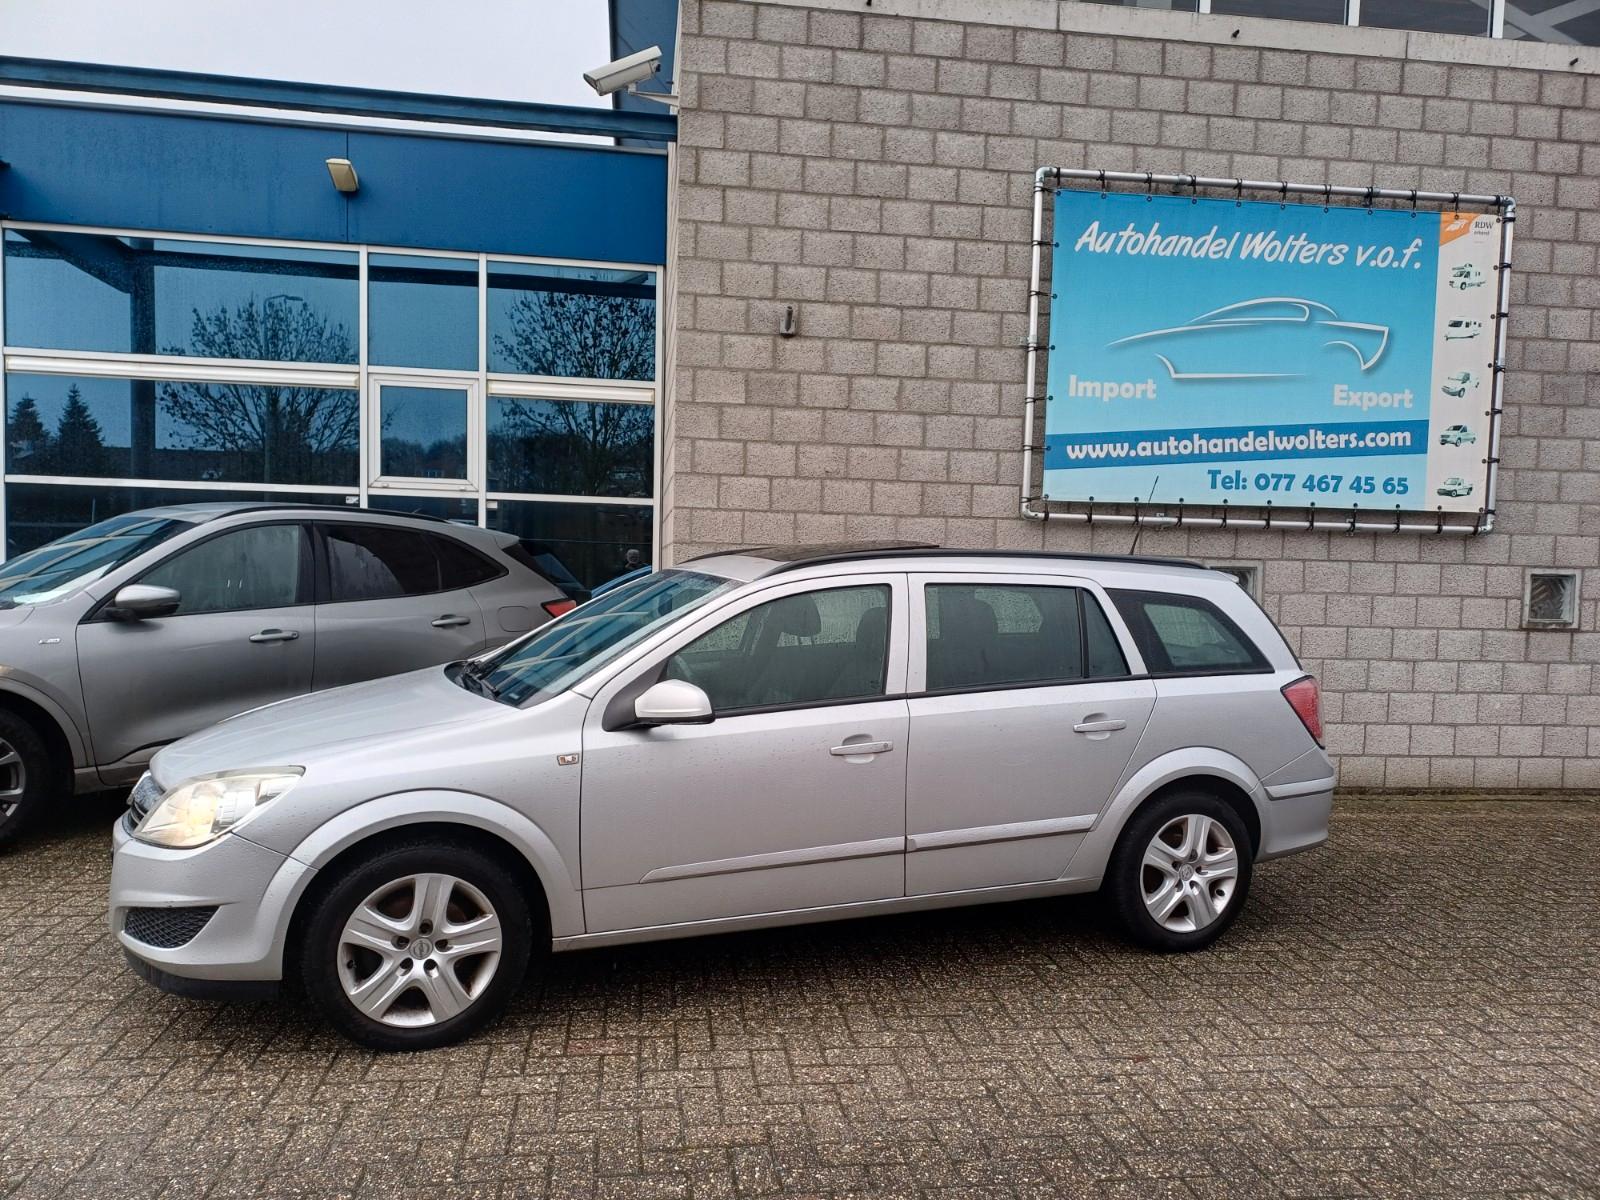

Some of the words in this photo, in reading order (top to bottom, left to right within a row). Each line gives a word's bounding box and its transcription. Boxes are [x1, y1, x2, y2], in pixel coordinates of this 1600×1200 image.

[1474, 220, 1495, 230] RDW
[1074, 220, 1241, 260] Autohandel
[1239, 230, 1349, 266] Wolters
[1355, 237, 1423, 270] v.o.f.
[1068, 374, 1157, 402] Import
[1333, 383, 1414, 412] Export
[1066, 428, 1412, 460] www.autohandelwolters.com
[1207, 469, 1248, 491] Tel:
[1254, 472, 1296, 492] 077
[1302, 474, 1344, 493] 467
[1349, 475, 1376, 494] 45
[1382, 477, 1409, 495] 65
